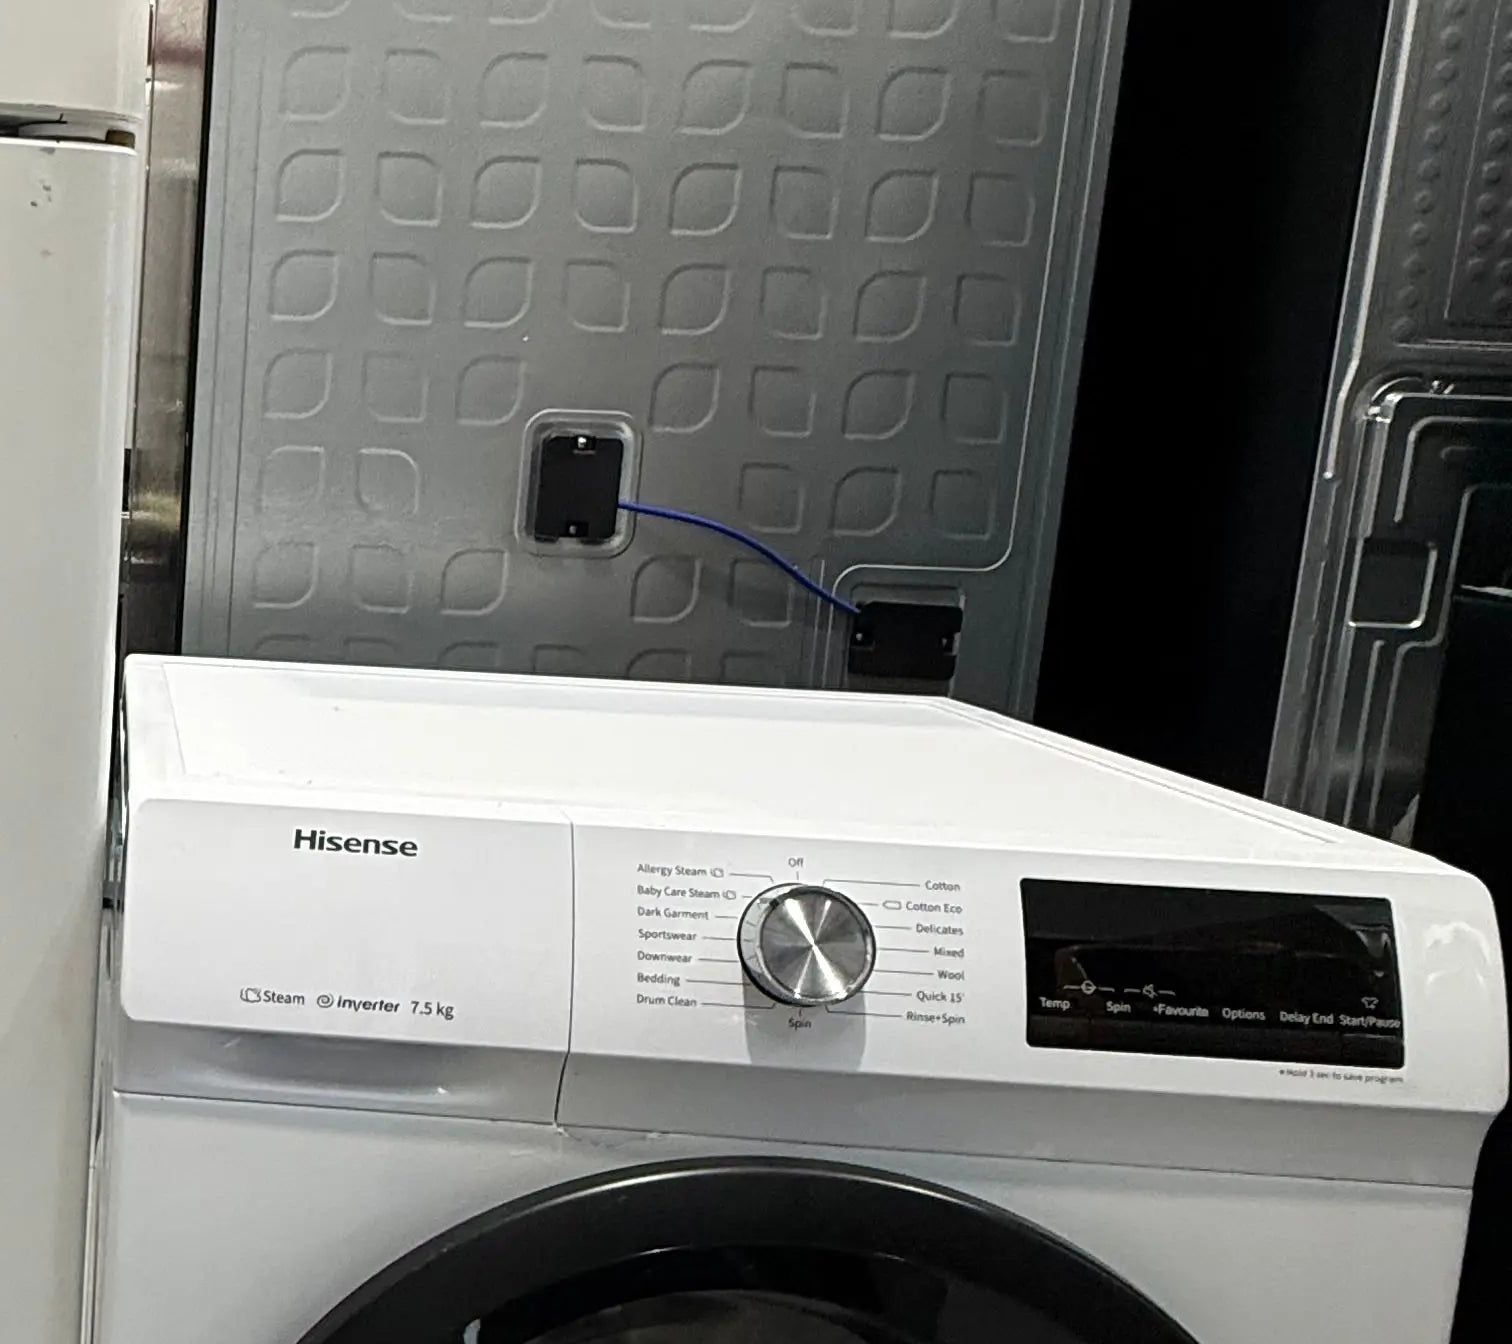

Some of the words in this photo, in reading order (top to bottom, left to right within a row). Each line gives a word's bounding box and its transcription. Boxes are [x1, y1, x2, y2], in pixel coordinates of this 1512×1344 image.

[293, 828, 418, 857] Hisense
[788, 857, 804, 868] Off
[637, 863, 672, 877] Allergy
[675, 865, 707, 876] Steam
[637, 885, 662, 898] Baby
[664, 887, 687, 897] Care
[689, 888, 720, 899] Steam
[925, 879, 961, 892] Cotton
[637, 906, 661, 917] Dark
[664, 907, 709, 920] Garment
[906, 901, 941, 913] Cotton
[944, 902, 963, 914] Eco
[638, 928, 697, 942] Sportswear
[916, 923, 964, 936] Delicates
[637, 950, 693, 963] Downwear
[934, 946, 965, 957] Mixed
[637, 972, 681, 986] Bedding
[937, 969, 965, 981] Wool
[637, 993, 666, 1005] Drum
[668, 995, 697, 1007] Clean
[916, 990, 947, 1003] Quick
[1039, 996, 1071, 1011] Temp
[263, 989, 305, 1006] Steam
[411, 1000, 433, 1016] 7.5
[436, 1001, 455, 1021] kg
[1106, 1000, 1131, 1014] Spin
[906, 1010, 965, 1026] Rinse+Spin
[1222, 1007, 1266, 1021] Options
[1280, 1010, 1310, 1025] Delay
[1312, 1012, 1334, 1024] End
[788, 1017, 812, 1029] Spin
[1339, 1014, 1401, 1029] Start/Pause
